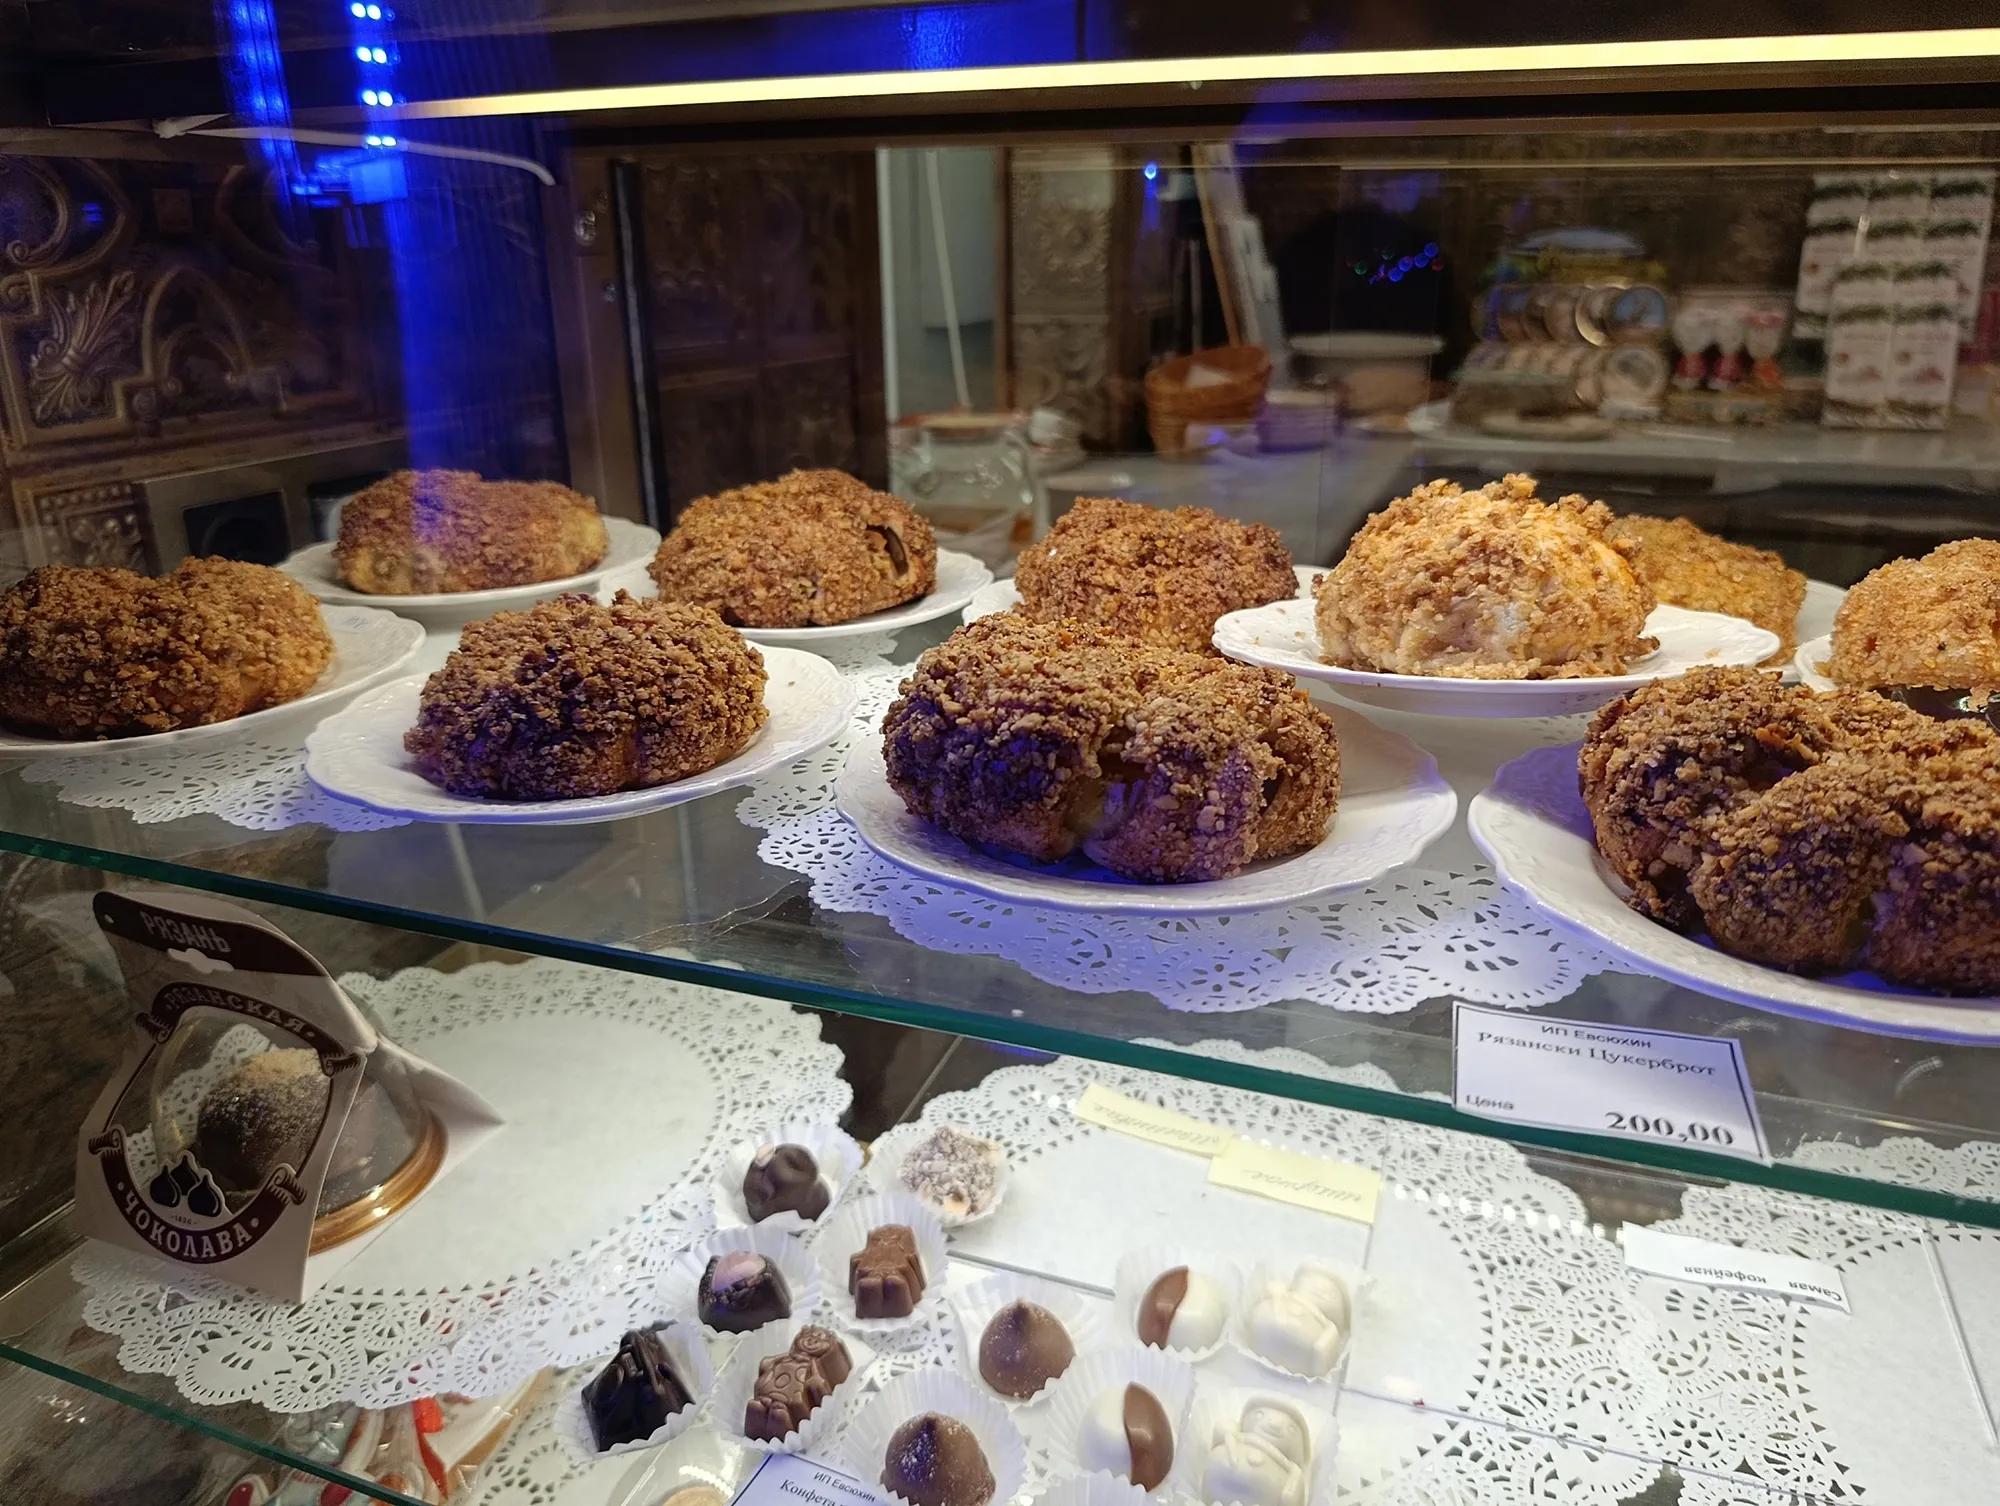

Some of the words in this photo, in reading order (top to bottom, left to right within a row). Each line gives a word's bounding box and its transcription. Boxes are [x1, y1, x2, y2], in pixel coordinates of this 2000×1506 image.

[140, 911, 231, 953] РЯЗАНЬ
[164, 987, 307, 1032] РЯЗАНСКАЯ
[1541, 1025, 1568, 1036] ИП
[1573, 1029, 1652, 1049] Евсюхин
[1477, 1031, 1581, 1057] Рязански
[1589, 1048, 1717, 1077] Цукерброт
[1465, 1094, 1515, 1111] Цена
[1605, 1111, 1734, 1146] 200,00
[124, 1189, 253, 1258] ЧОКОЛАВА
[1684, 1266, 1768, 1284] кофейная
[1788, 1281, 1843, 1302] Самая
[814, 1471, 832, 1485] ИП
[832, 1479, 876, 1503] Евсюхин
